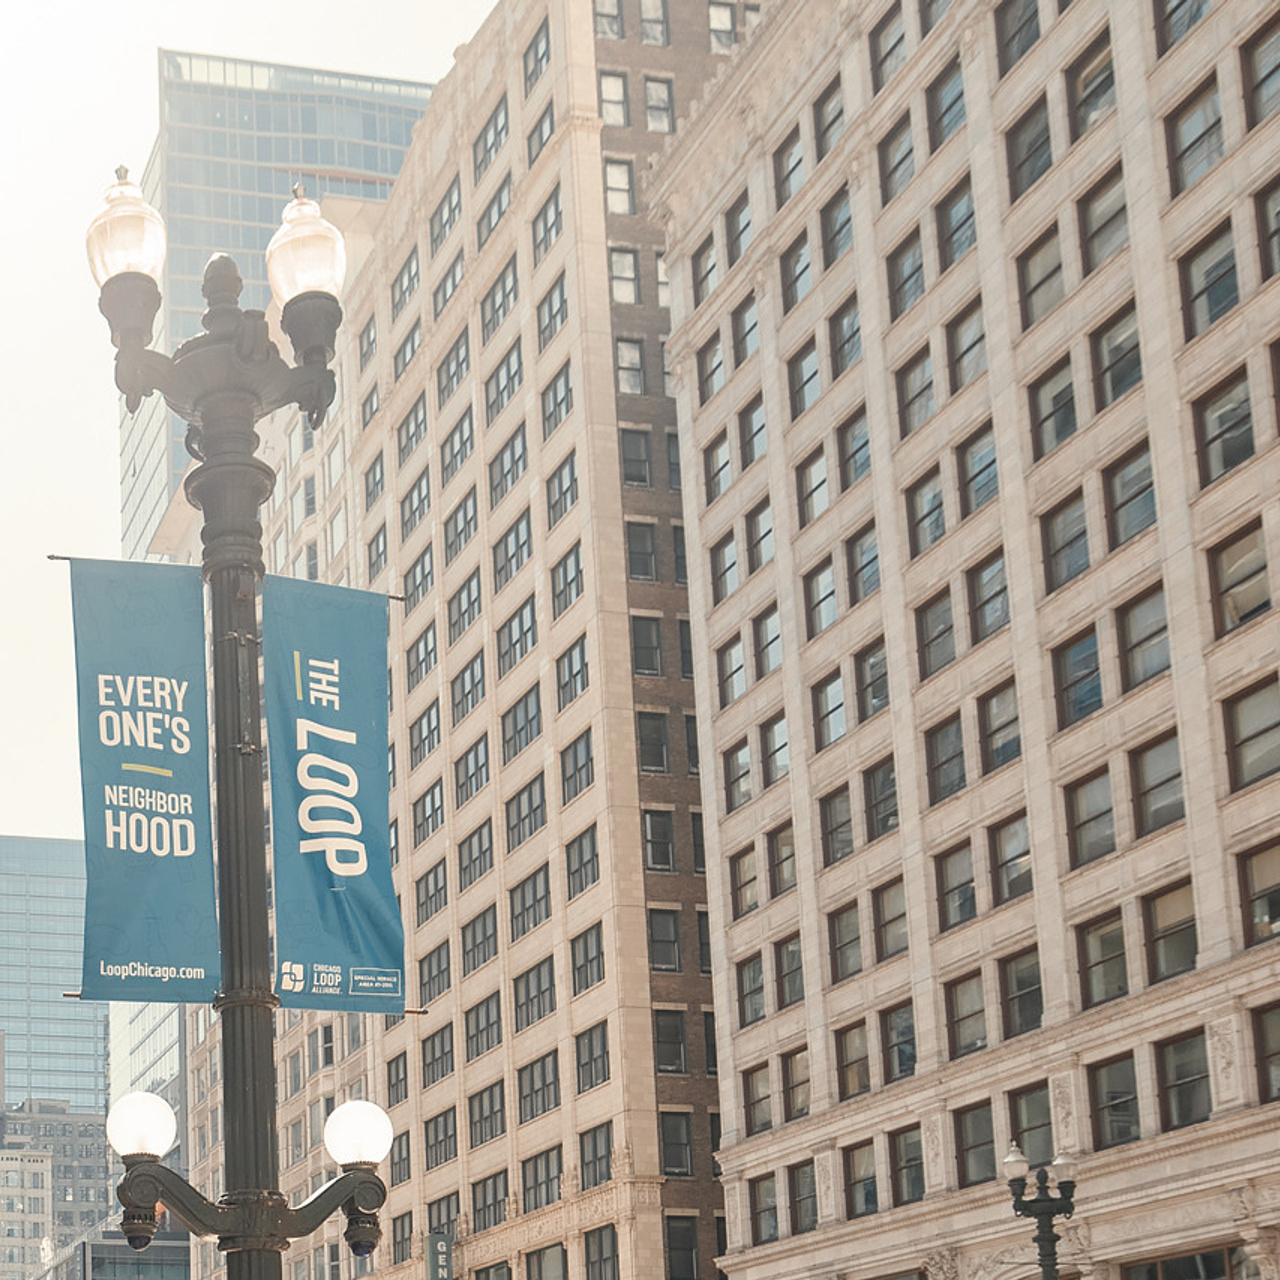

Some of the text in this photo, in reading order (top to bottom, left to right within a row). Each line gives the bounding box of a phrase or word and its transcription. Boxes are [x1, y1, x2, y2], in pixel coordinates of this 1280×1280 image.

[97, 674, 189, 712] EVERY
[98, 710, 191, 754] ONE'S
[295, 659, 368, 877] THE LOOP
[104, 785, 193, 814] NEIGHBOR
[105, 809, 196, 857] HOOD
[99, 960, 205, 981] LoopChicago.com
[313, 963, 342, 973] CHICAGO
[313, 973, 342, 986] LOOP
